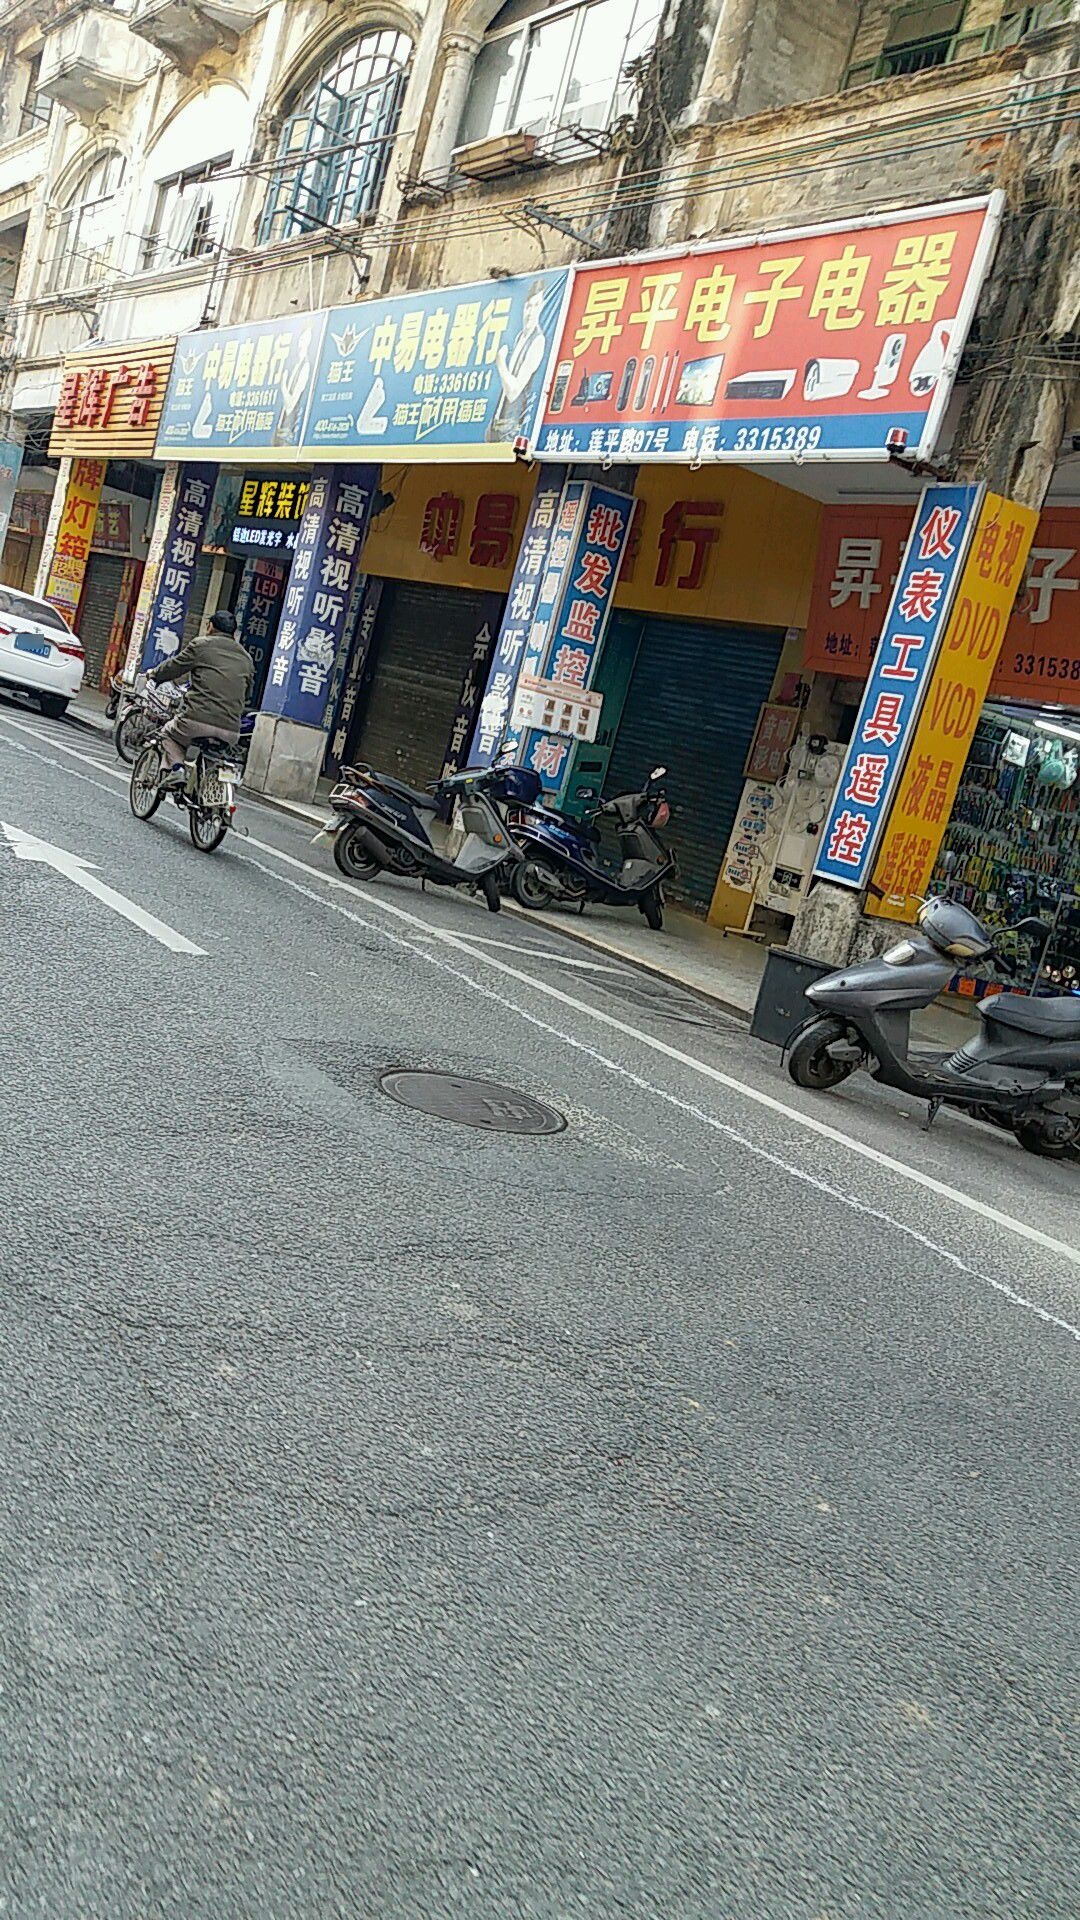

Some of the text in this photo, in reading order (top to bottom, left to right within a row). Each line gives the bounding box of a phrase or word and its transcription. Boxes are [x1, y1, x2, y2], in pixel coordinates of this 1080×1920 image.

[572, 230, 959, 358] 昇平电子电器
[203, 332, 293, 391] 中易电器行
[368, 298, 512, 375] 中易电器行
[54, 363, 158, 428] 星辉广告
[327, 360, 356, 383] 猫王
[392, 397, 489, 435] 猫王耐用插座
[271, 476, 329, 688] 高清视听影音
[975, 519, 1025, 588] 电视
[246, 597, 275, 638] 灯箱
[255, 578, 278, 600] LED
[298, 482, 369, 697] 高清视听影音
[530, 503, 623, 778] 批发监控材
[949, 597, 1001, 661] DVD
[827, 506, 961, 866] 仪表工具遥控
[928, 678, 977, 740] VCD
[902, 754, 953, 824] 液晶
